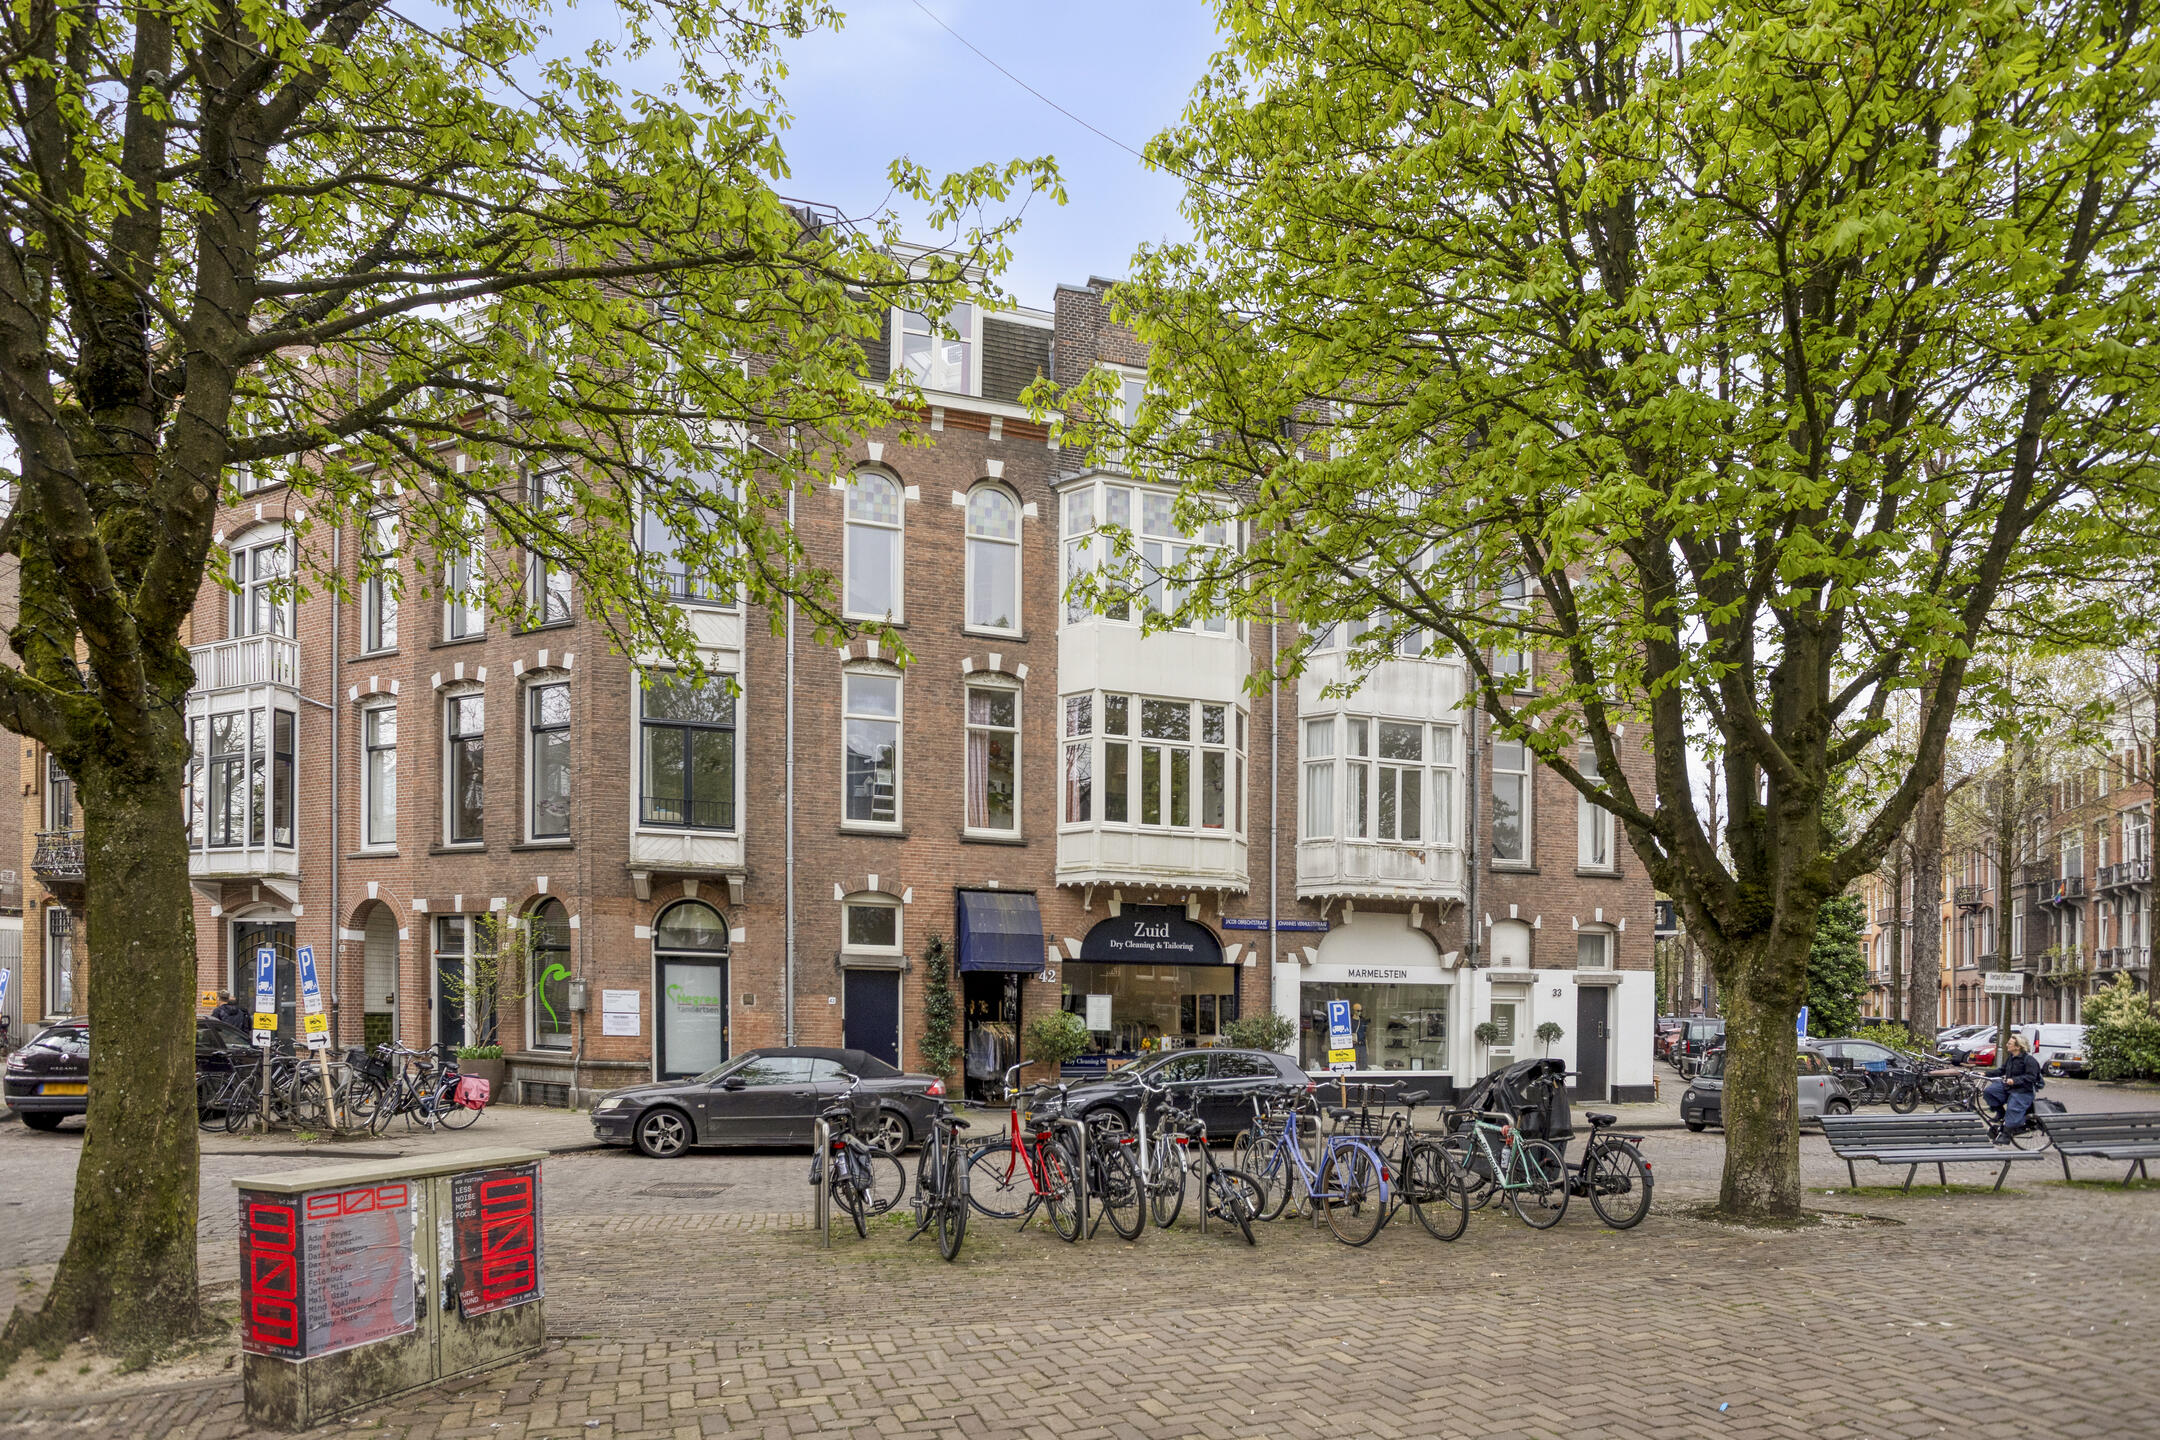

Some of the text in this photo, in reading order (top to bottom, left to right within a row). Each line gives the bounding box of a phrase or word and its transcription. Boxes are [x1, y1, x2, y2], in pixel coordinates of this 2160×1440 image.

[1134, 921, 1170, 938] Zuid
[1110, 940, 1124, 949] Dry
[1125, 940, 1155, 950] Cleaning
[1164, 941, 1194, 950] Tailoring
[261, 953, 271, 976] P
[300, 951, 311, 976] P
[1038, 970, 1056, 983] 42
[1348, 969, 1407, 979] MARMELSTEIN
[1552, 988, 1562, 997] 33
[678, 1006, 719, 1014] tandartsen
[1332, 1003, 1345, 1022] P
[1076, 1057, 1100, 1066] Cleaning
[455, 1186, 472, 1195] LESS
[455, 1193, 476, 1202] NOISE
[455, 1201, 473, 1210] MORE
[456, 1209, 477, 1218] FOCUS
[308, 1230, 352, 1242] Adam Beyer
[308, 1251, 331, 1260] Daria
[308, 1270, 326, 1278] Eric
[331, 1281, 353, 1290] Mills
[308, 1303, 328, 1312] Mind
[308, 1313, 326, 1321] Paul
